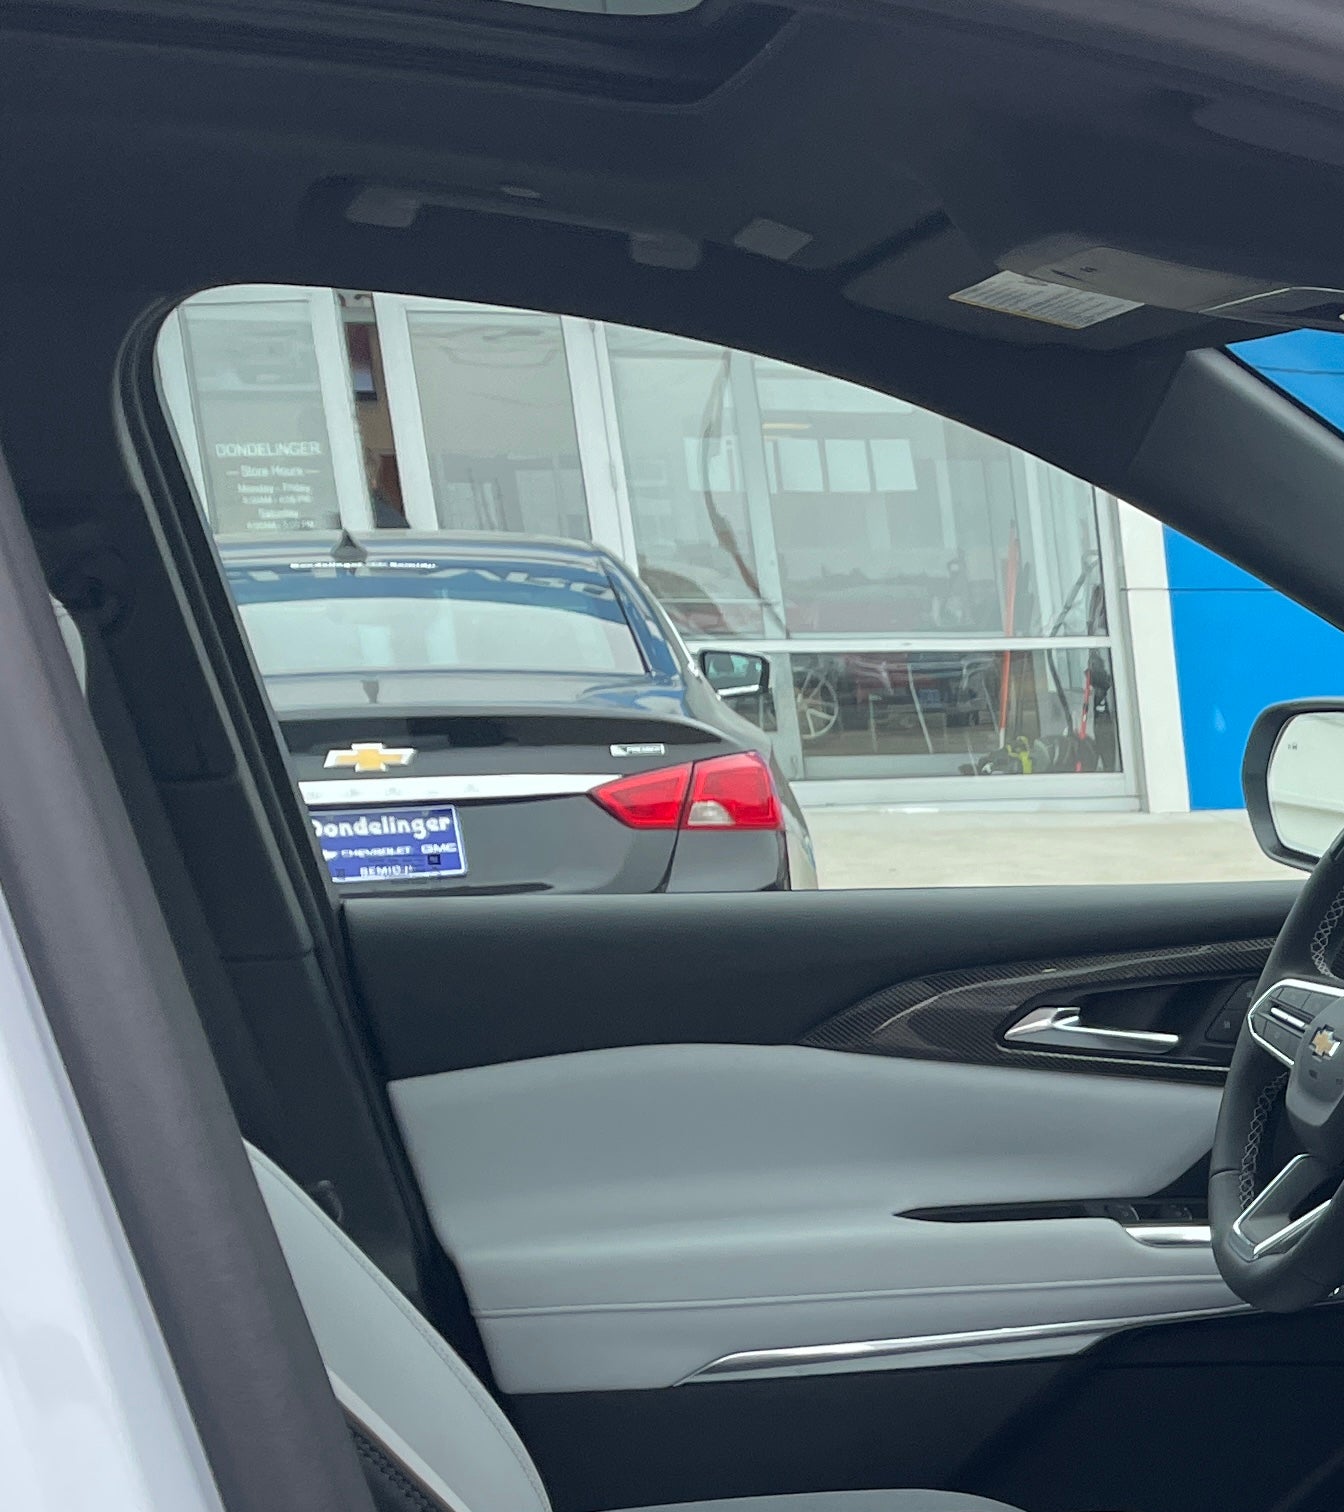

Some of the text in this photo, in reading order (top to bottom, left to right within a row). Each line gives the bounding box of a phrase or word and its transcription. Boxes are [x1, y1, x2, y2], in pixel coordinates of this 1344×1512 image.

[215, 441, 321, 456] DONDELINGER
[341, 843, 458, 859] CHEVROLET GMC
